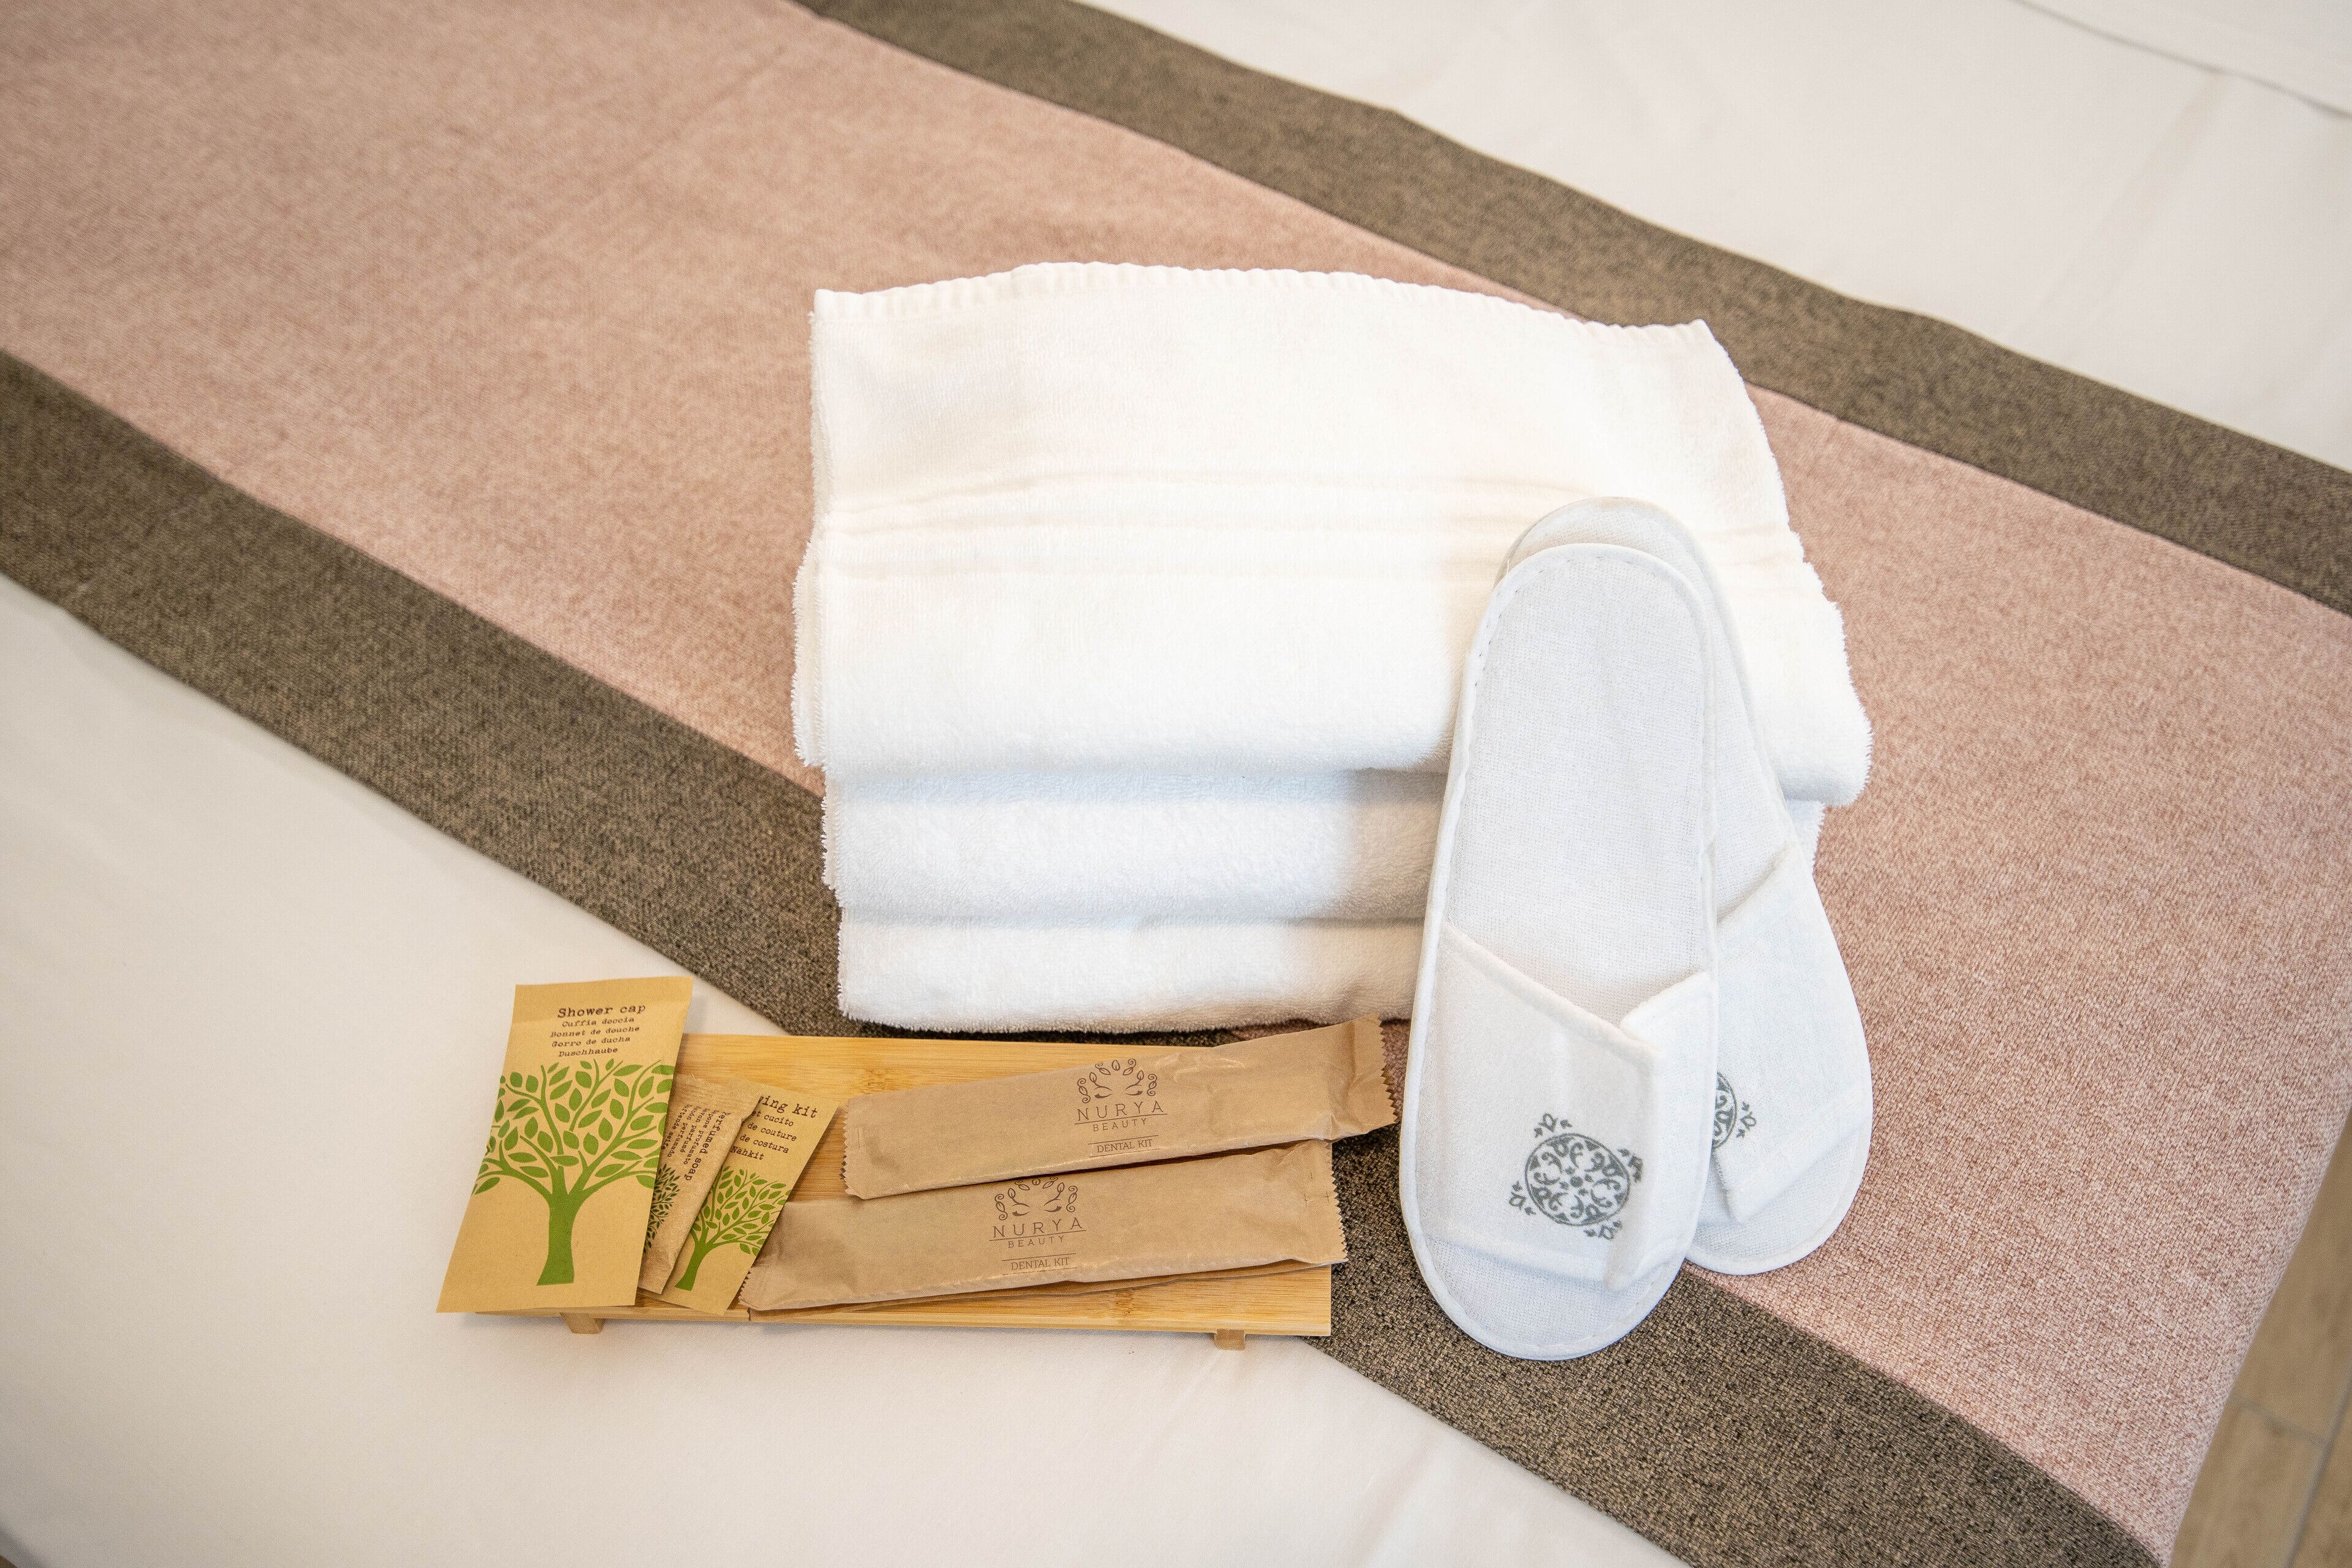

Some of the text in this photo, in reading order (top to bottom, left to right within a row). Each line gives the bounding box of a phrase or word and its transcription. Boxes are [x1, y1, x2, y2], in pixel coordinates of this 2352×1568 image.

[557, 1005, 646, 1019] Shower cap
[557, 1047, 618, 1057] Duschhaube
[792, 1104, 818, 1118] kit
[1077, 1101, 1164, 1121] NURYA
[764, 1114, 794, 1127] cucito
[1093, 1118, 1147, 1131] BEAUTY
[667, 1122, 688, 1158] perfumado
[680, 1125, 697, 1153] parfumé
[747, 1122, 758, 1131] de
[760, 1128, 797, 1142] couture
[683, 1130, 704, 1165] profumato
[740, 1134, 790, 1154] de costura
[1097, 1139, 1153, 1153] DENTAL KIT
[684, 1158, 701, 1181] soap
[993, 1217, 1082, 1238] NURYA
[1008, 1235, 1065, 1248] BEAUTY
[1011, 1257, 1069, 1270] DENTAL KIT
